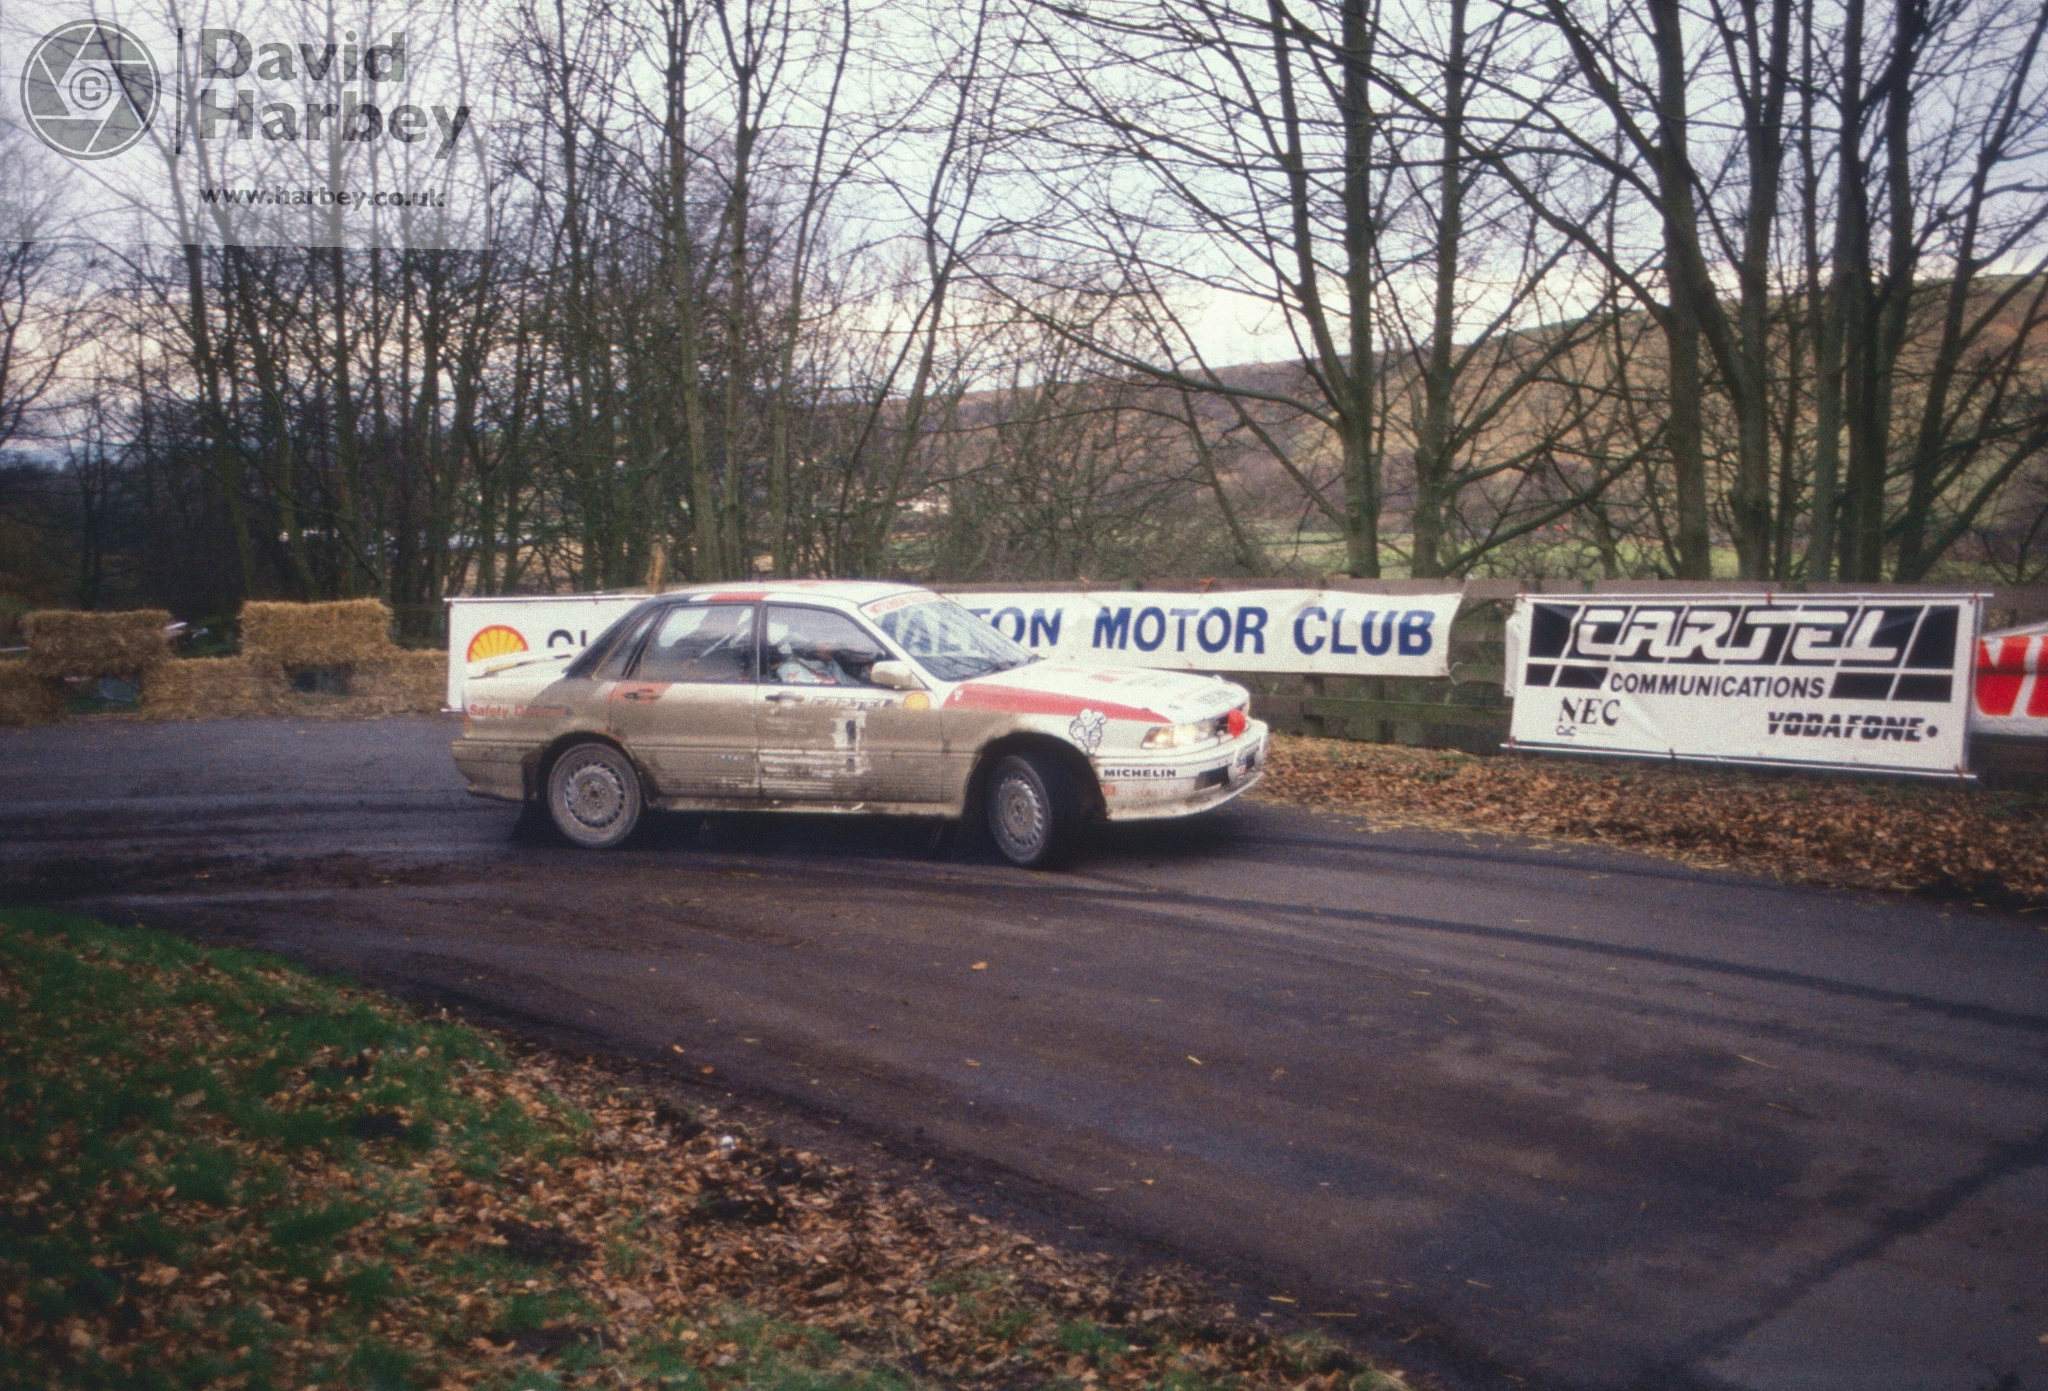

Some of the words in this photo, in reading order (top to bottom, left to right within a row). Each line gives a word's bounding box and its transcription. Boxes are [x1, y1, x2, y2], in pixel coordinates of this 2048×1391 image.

[1093, 606, 1269, 655] MOTOR
[1293, 606, 1436, 656] CLUB
[1576, 609, 1898, 661] CARTEL
[1610, 672, 1825, 699] COMMUNICATIONS
[1558, 696, 1621, 726] NEC
[1768, 711, 1924, 742] VODAFONE
[1104, 769, 1177, 778] MICHELIN
